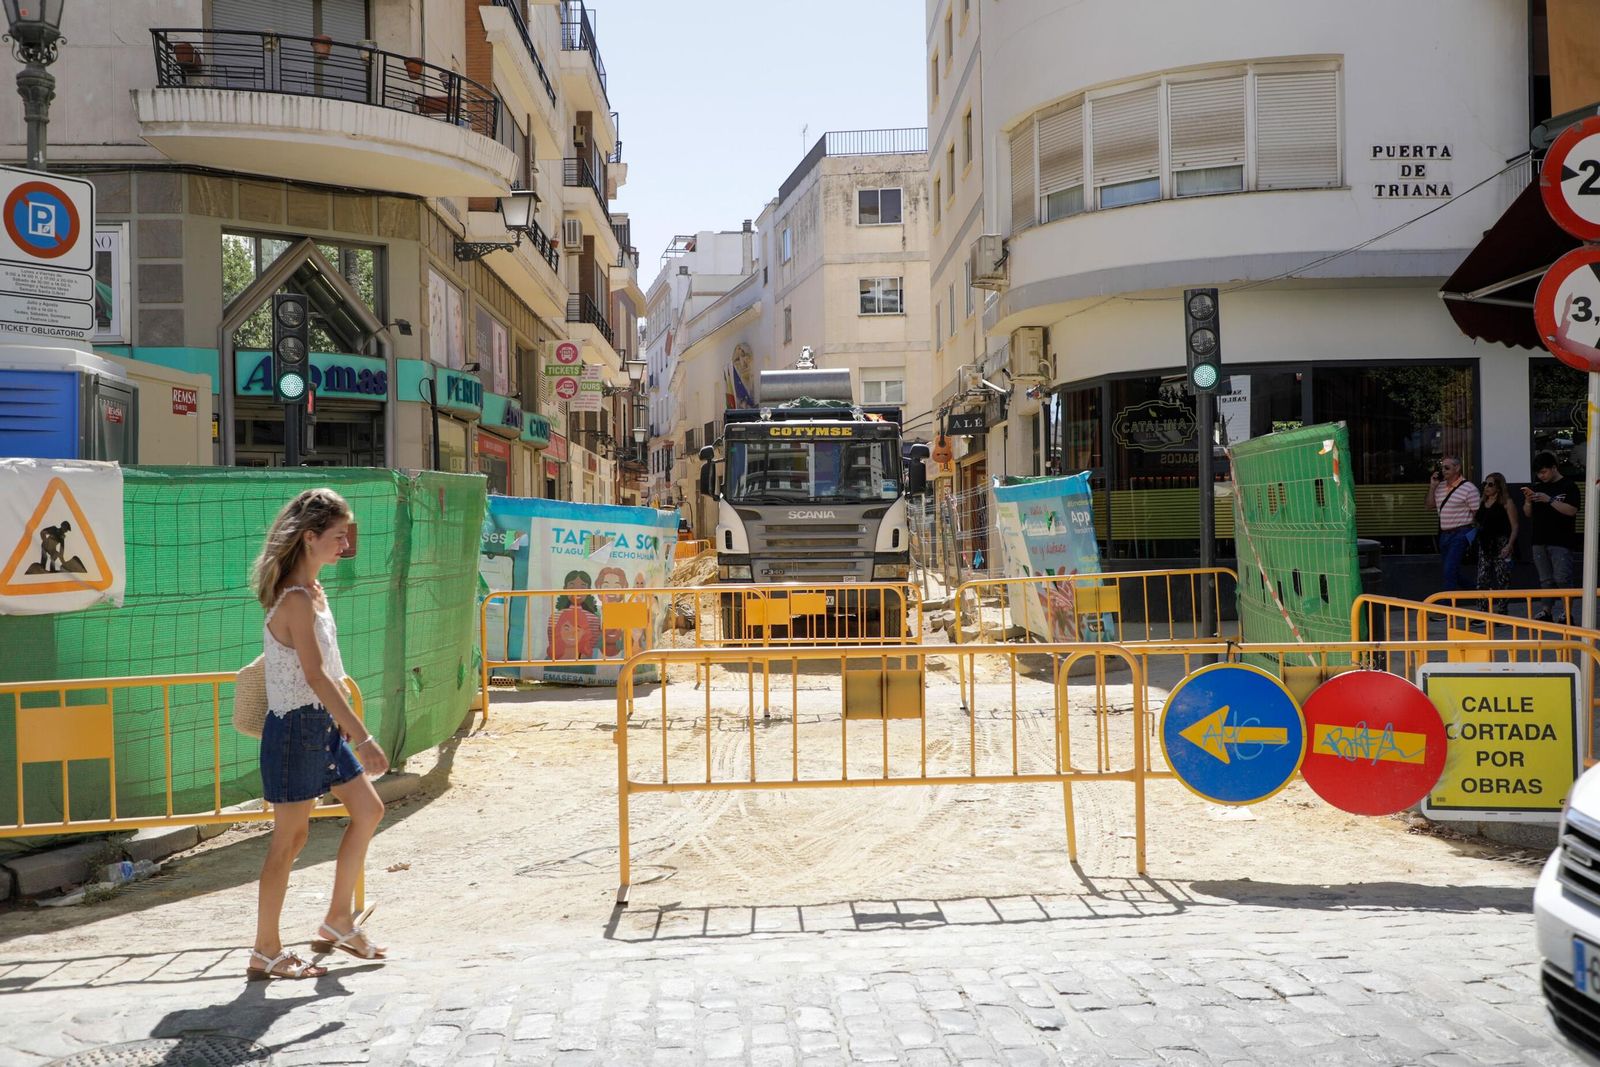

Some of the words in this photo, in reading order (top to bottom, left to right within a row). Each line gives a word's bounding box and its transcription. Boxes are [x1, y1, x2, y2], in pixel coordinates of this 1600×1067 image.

[1372, 145, 1452, 158] PUERTA
[1401, 164, 1425, 177] DE
[1374, 184, 1452, 197] TRIANA
[0, 323, 29, 333] TICKET
[31, 326, 85, 338] OBLIGATORIO
[548, 366, 580, 375] TICKETS
[581, 383, 600, 391] OURS
[173, 389, 196, 404] REMSA
[769, 427, 852, 436] COTYMSE
[1121, 417, 1187, 434] CATALINA
[788, 510, 836, 519] SCANIA
[1070, 510, 1091, 526] App
[552, 546, 563, 554] TU
[564, 547, 584, 556] AGU
[1461, 696, 1534, 713] CALLE
[1445, 723, 1557, 741] CORTADA
[1476, 750, 1525, 767] POR
[1461, 777, 1543, 794] OBRAS
